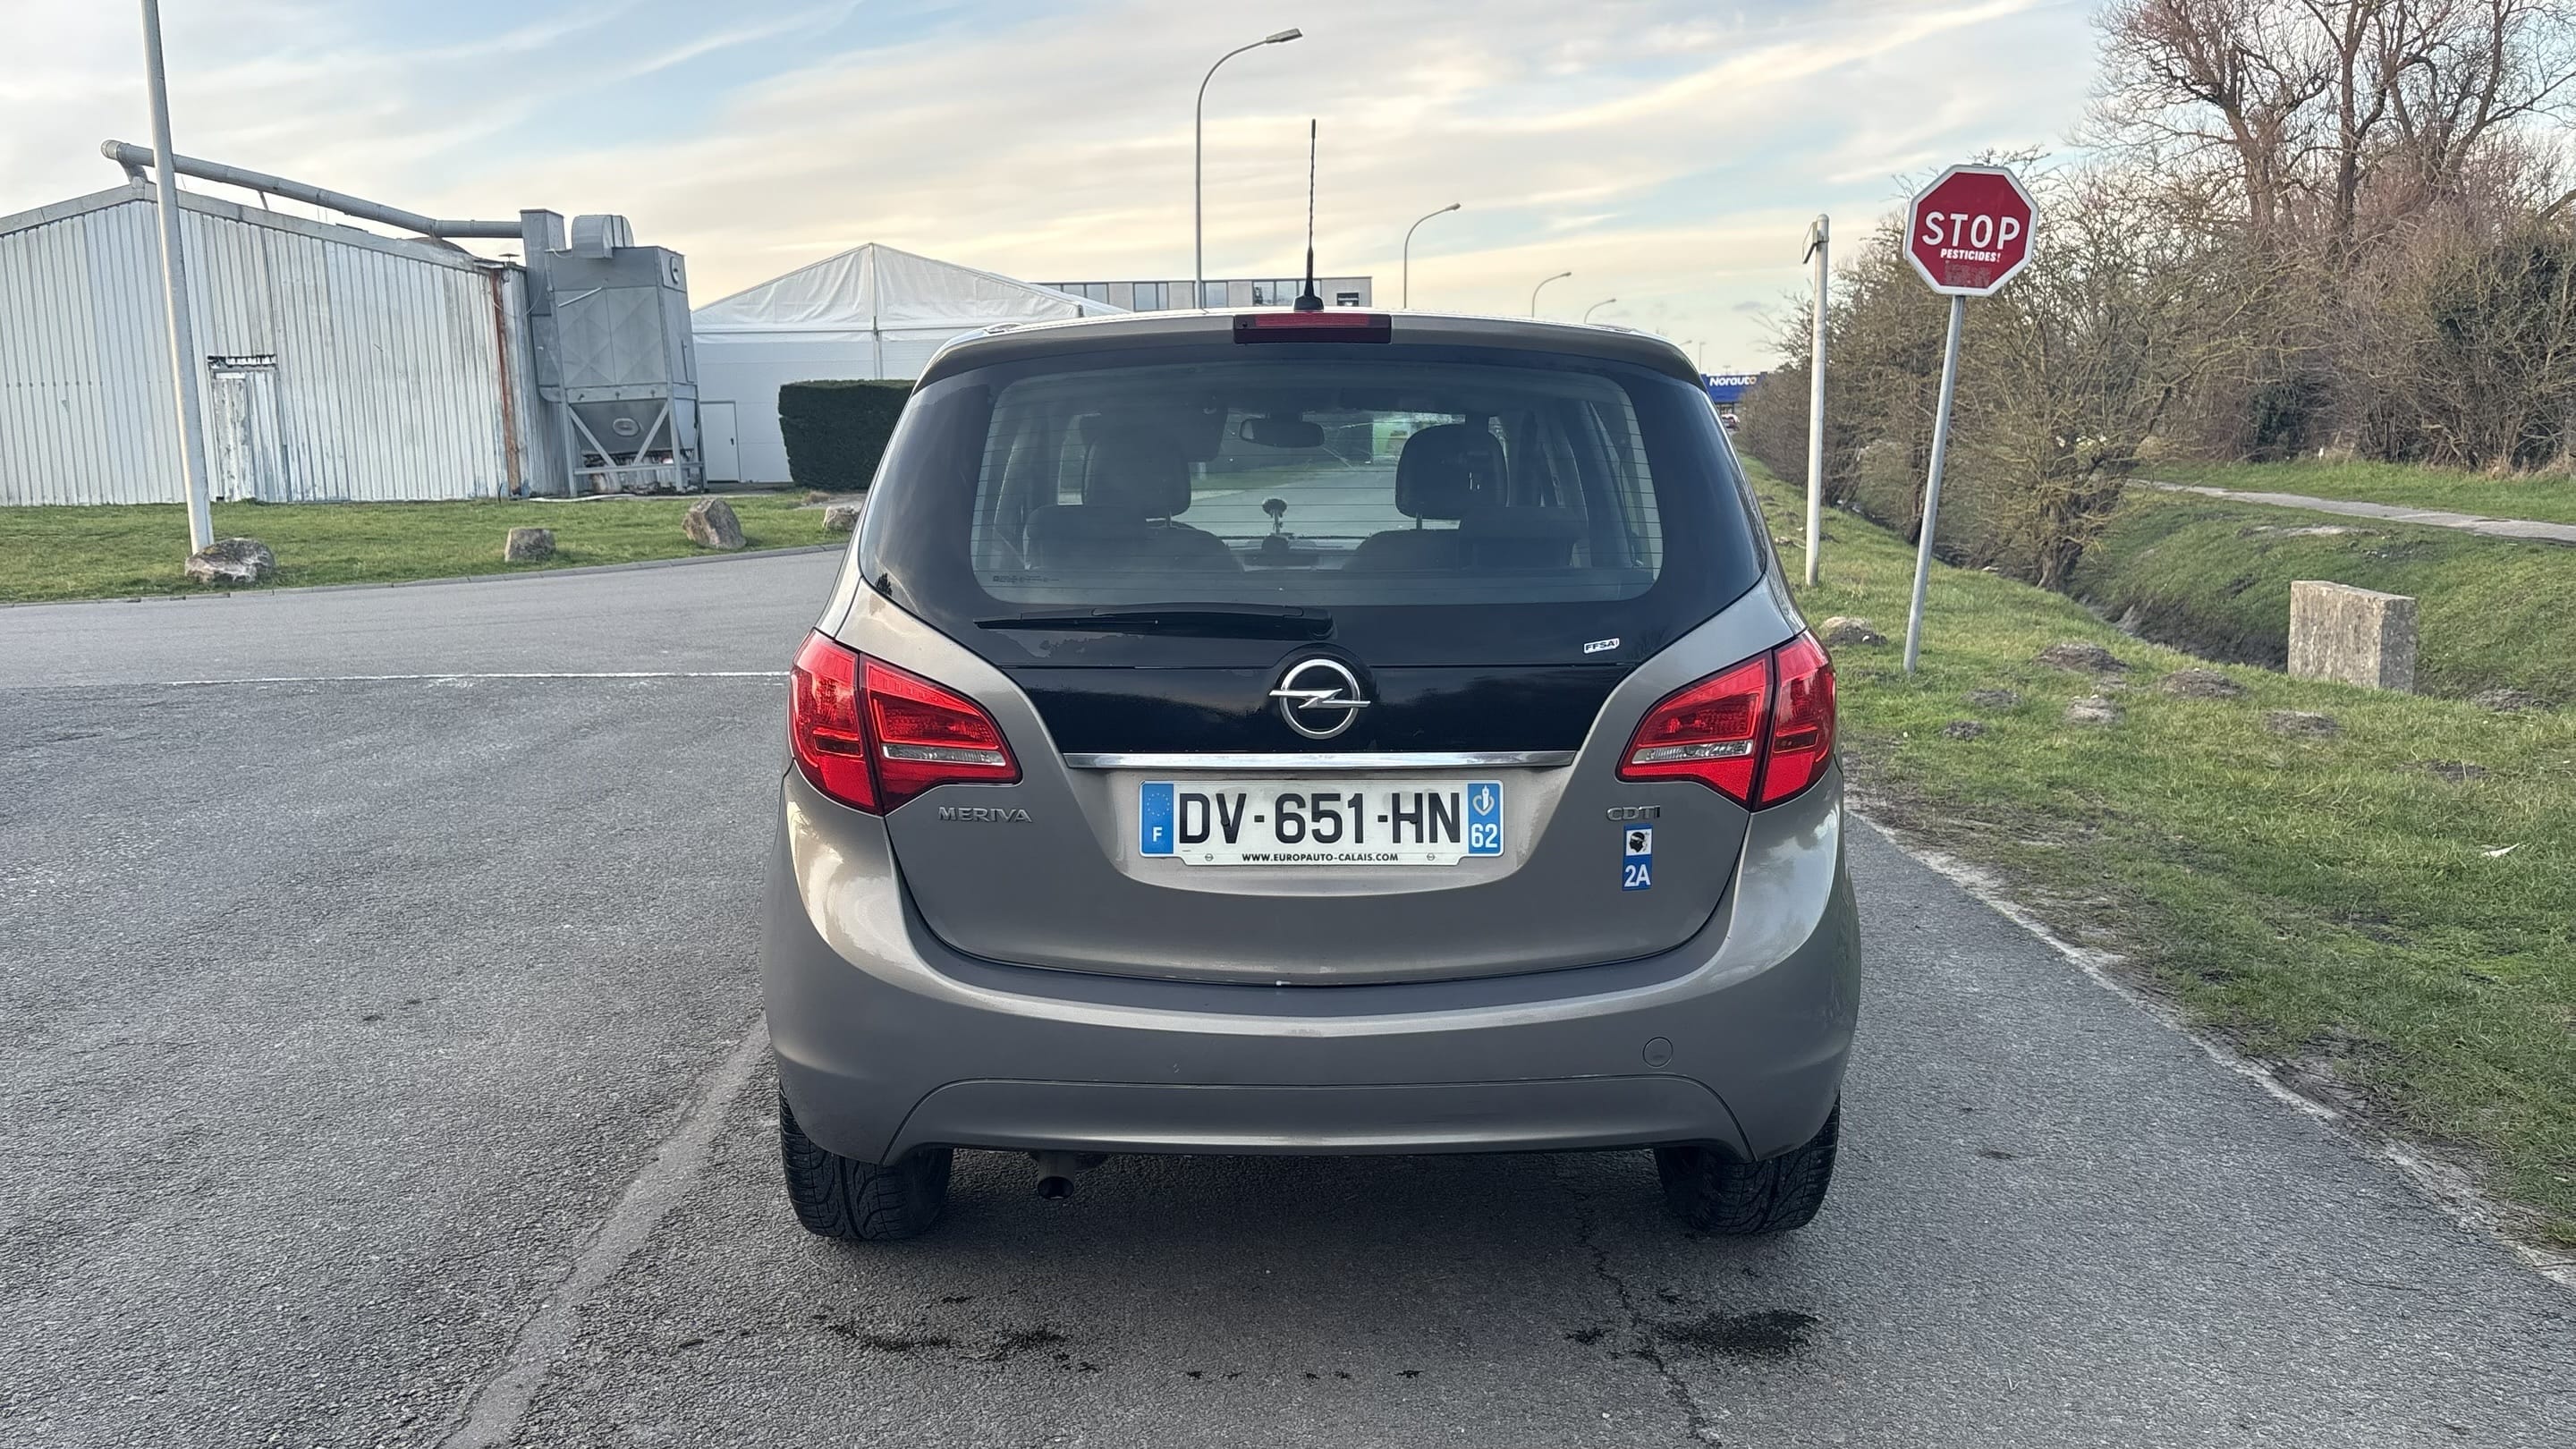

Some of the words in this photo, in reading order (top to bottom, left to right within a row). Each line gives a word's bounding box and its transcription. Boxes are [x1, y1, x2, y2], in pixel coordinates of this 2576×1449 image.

[1922, 211, 2021, 250] STOP
[1940, 248, 2002, 263] PESTICIDES!
[1709, 376, 1757, 386] Norauto
[938, 807, 1032, 823] MERIVA
[1179, 792, 1461, 844] DV-651-HN
[1607, 805, 1661, 820] CDTI
[1153, 826, 1163, 842] F
[1471, 823, 1498, 848] 62
[1241, 852, 1399, 861] WWW.EUROPAUTO-CALAIS.COM
[1624, 863, 1651, 887] 2A
